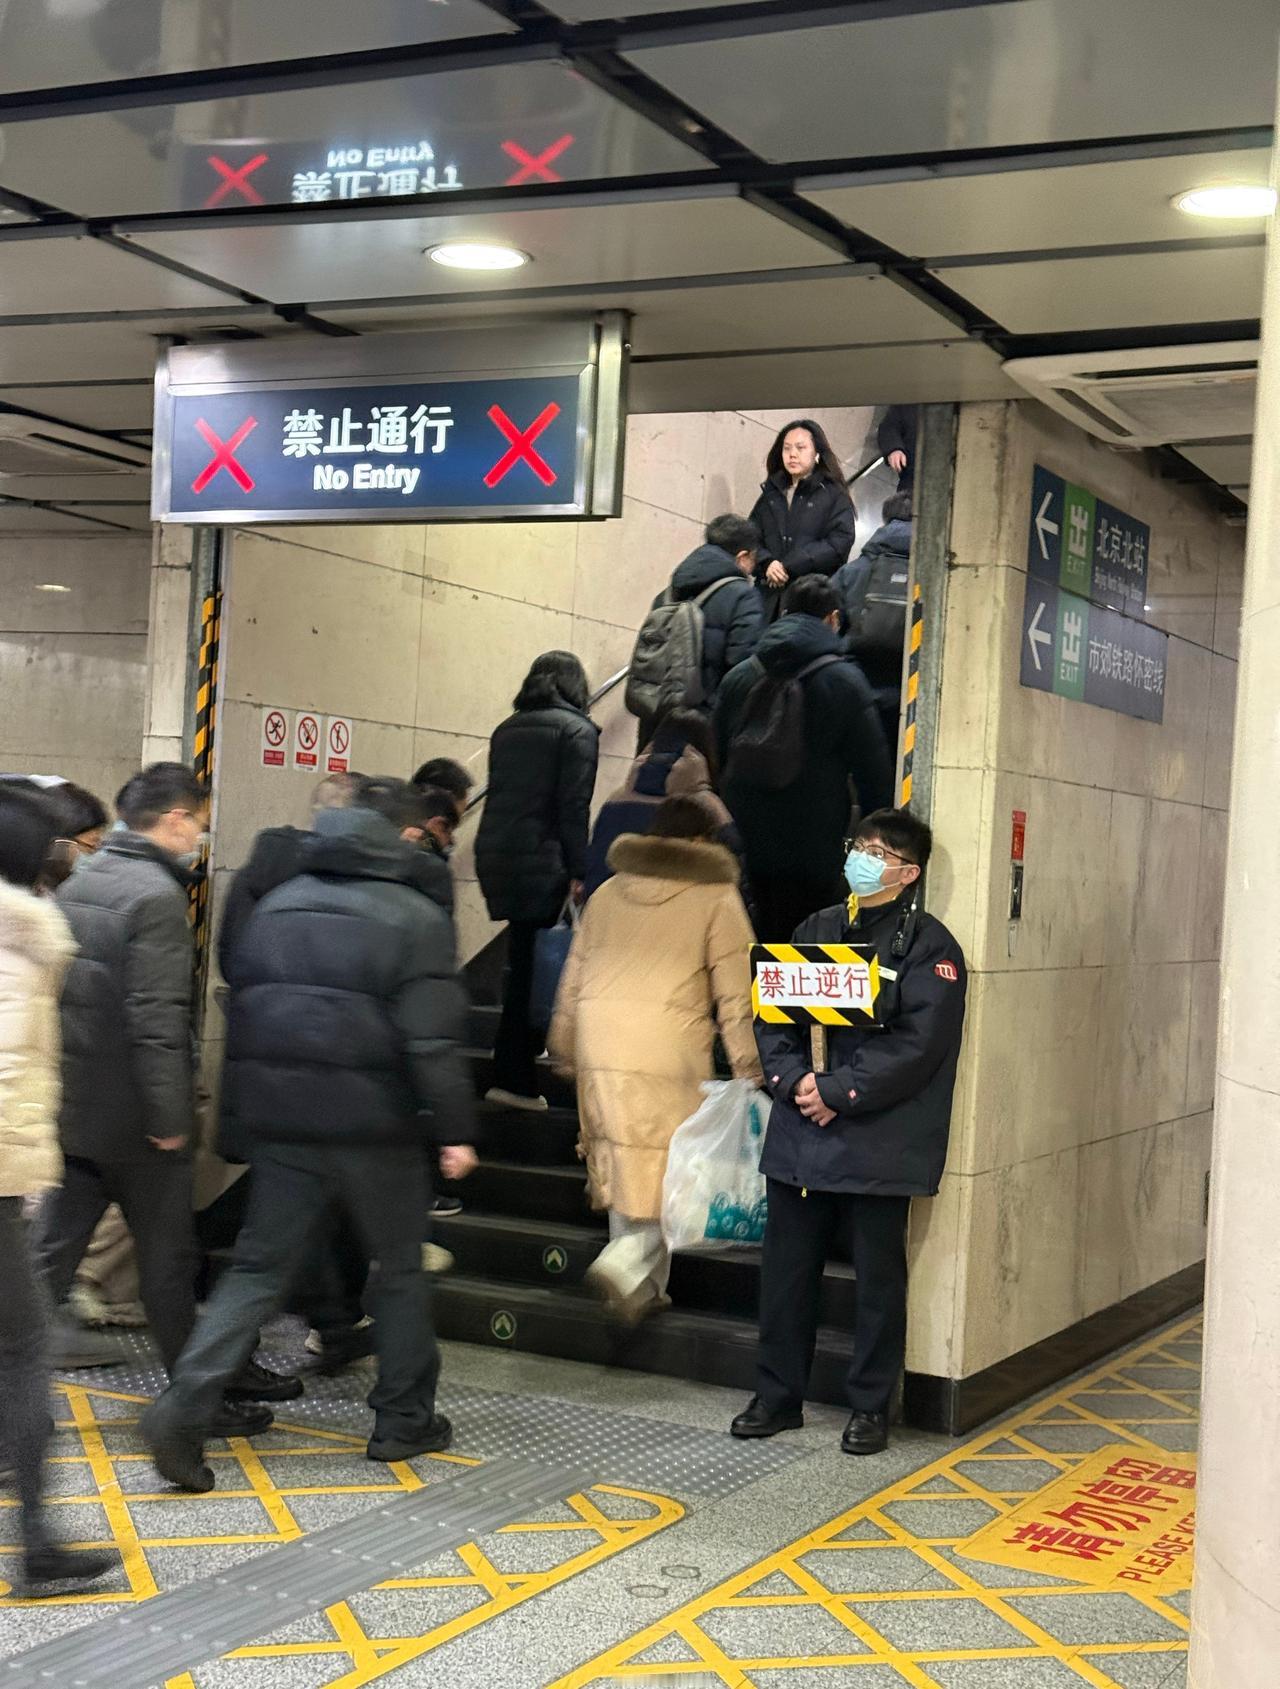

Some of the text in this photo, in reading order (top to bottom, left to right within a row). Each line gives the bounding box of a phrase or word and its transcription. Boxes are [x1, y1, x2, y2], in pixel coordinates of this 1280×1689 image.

[282, 404, 454, 458] 禁止通行
[313, 463, 421, 494] No Entry
[1096, 517, 1145, 576] 北京北站
[1060, 662, 1079, 683] EXIT
[1089, 638, 1164, 695] 市郊铁路怀密线
[760, 966, 869, 999] 禁止逆行
[1003, 1457, 1197, 1561] 请勿停留
[1116, 1534, 1194, 1584] PLEASE
